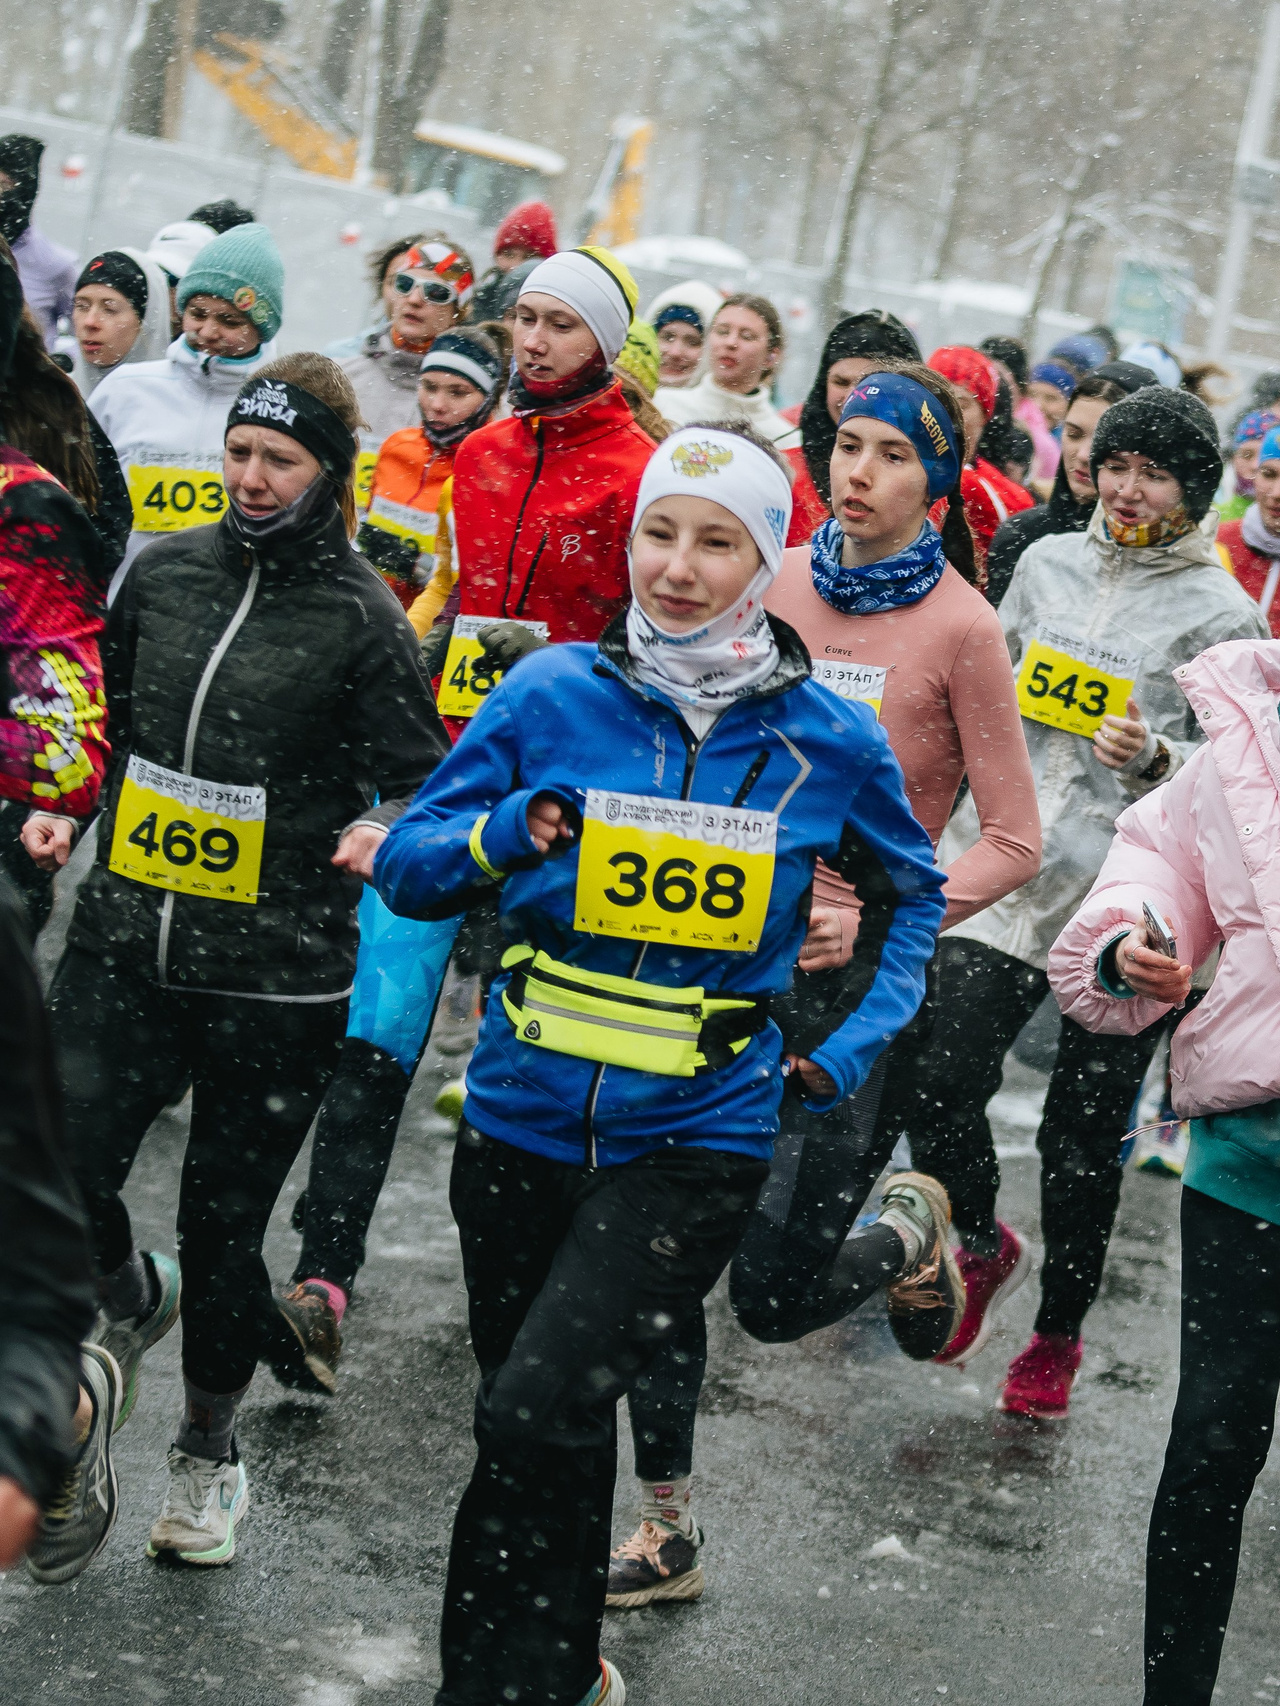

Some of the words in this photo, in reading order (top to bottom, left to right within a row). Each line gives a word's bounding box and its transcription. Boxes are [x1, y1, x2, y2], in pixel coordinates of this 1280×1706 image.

[238, 398, 298, 427] ЗИМА
[920, 400, 949, 456] BEGYM
[143, 481, 224, 513] 403
[1088, 647, 1096, 656] 3
[1098, 650, 1128, 666] ЭТАП
[824, 669, 832, 679] 3
[836, 671, 873, 684] ЭТАП
[1026, 660, 1110, 718] 543
[201, 788, 210, 799] 3
[214, 791, 252, 805] ЭТАП
[705, 816, 715, 828] 3
[721, 819, 762, 834] ЭТАП
[128, 811, 240, 874] 469
[603, 851, 746, 919] 368
